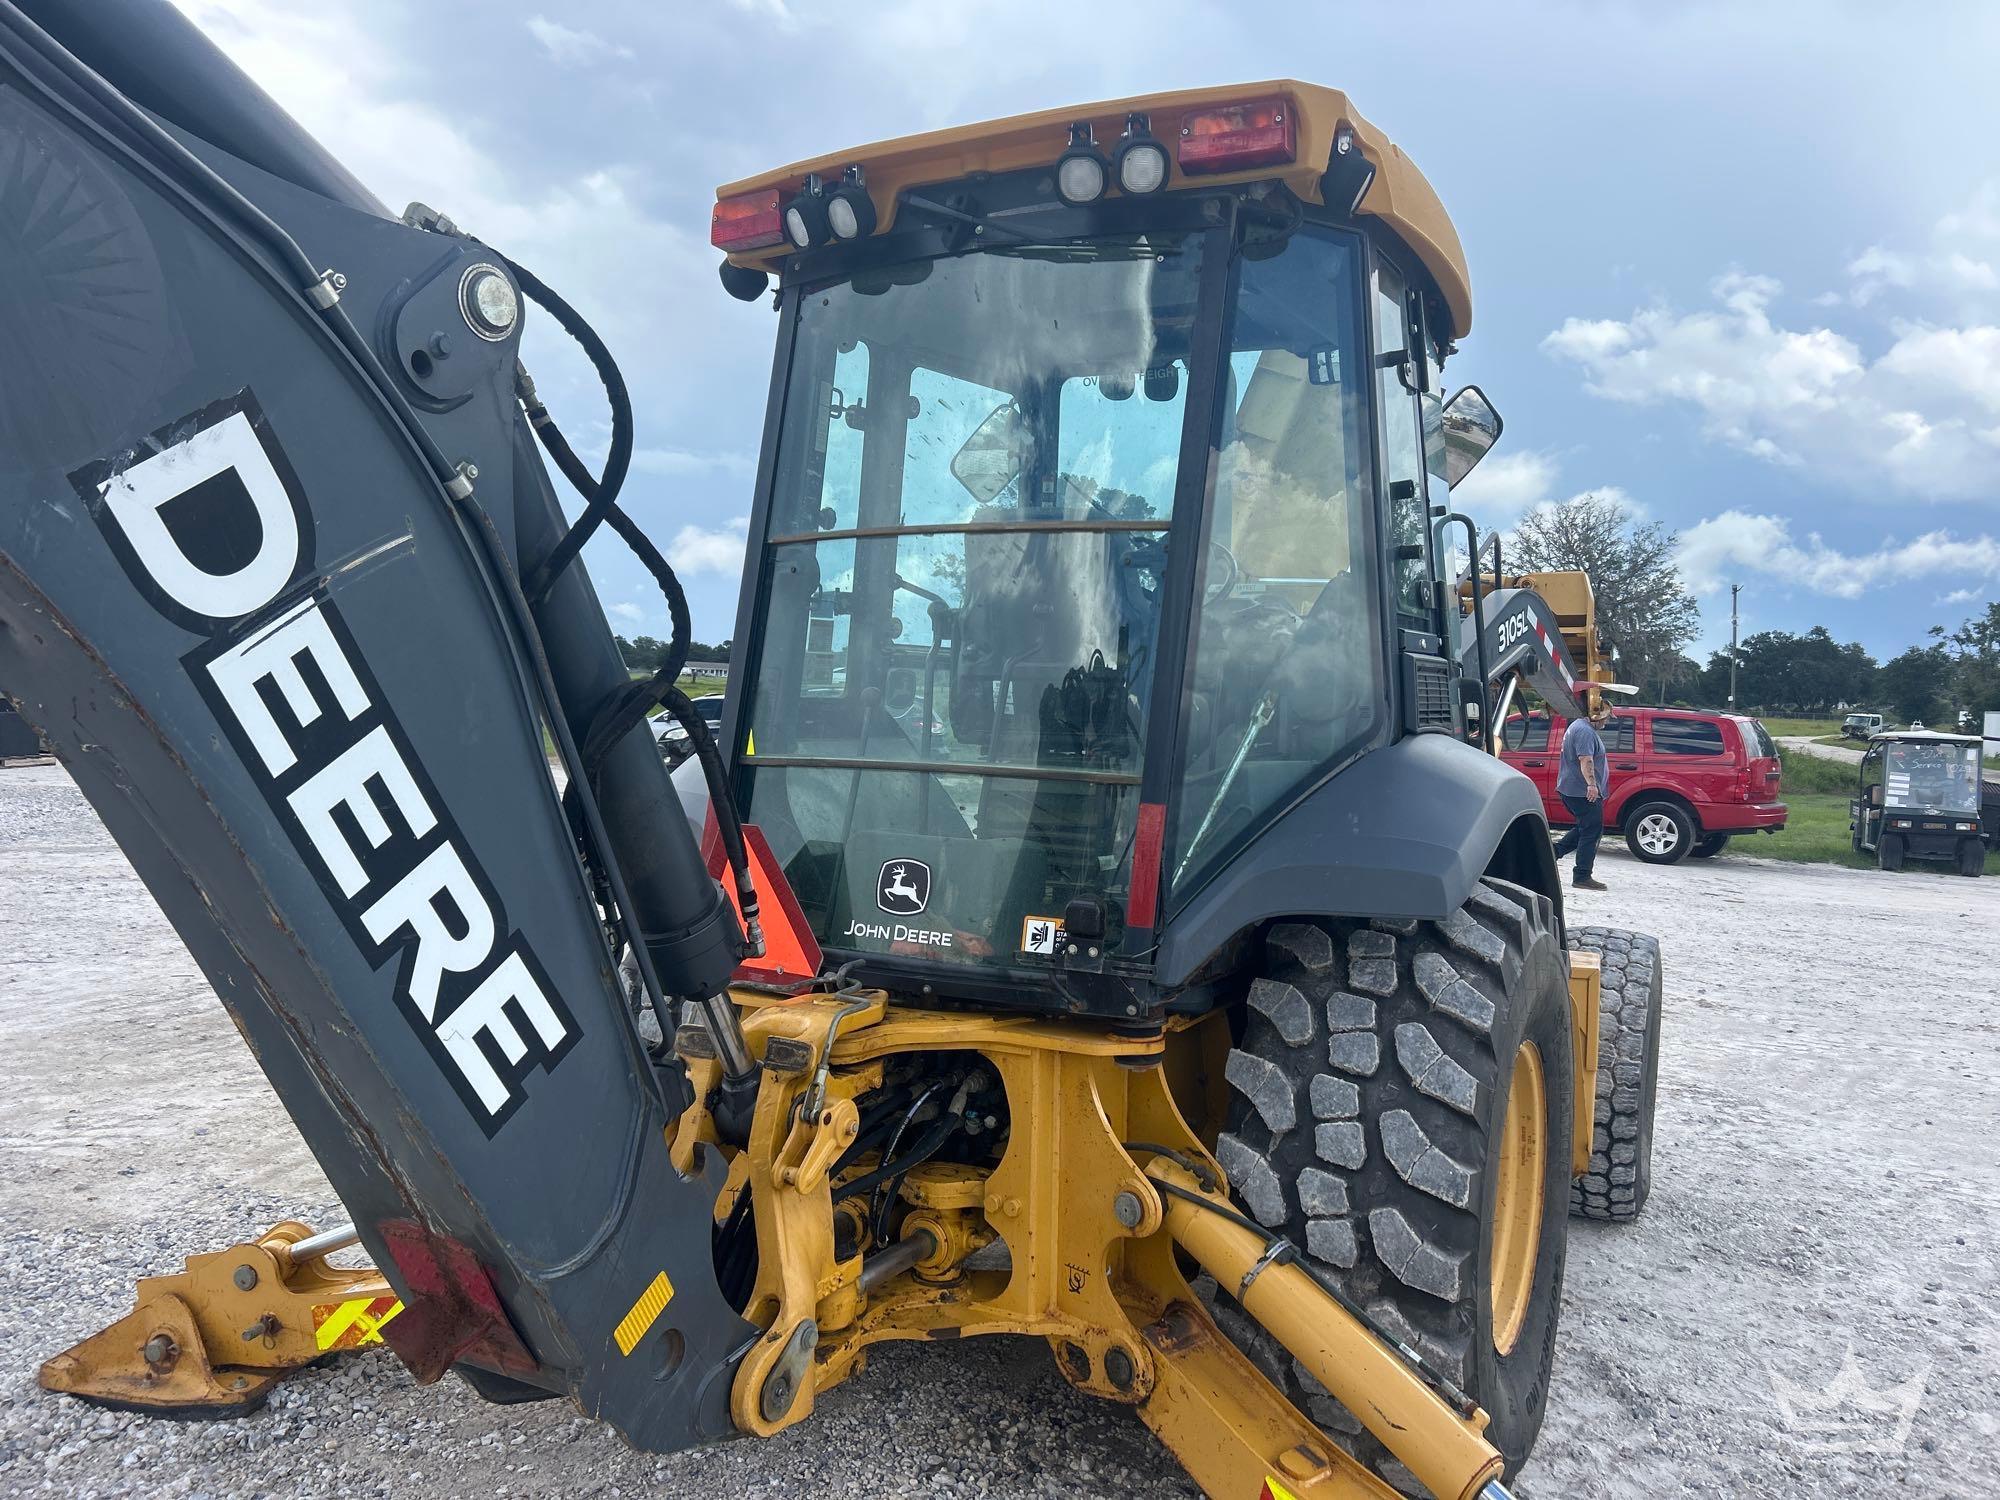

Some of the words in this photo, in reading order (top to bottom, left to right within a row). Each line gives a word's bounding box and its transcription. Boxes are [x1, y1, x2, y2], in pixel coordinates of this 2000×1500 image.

[1498, 611, 1529, 652] 310SL
[97, 411, 568, 1117] DEERE
[843, 919, 891, 940] JOHN
[893, 924, 953, 947] DEERE
